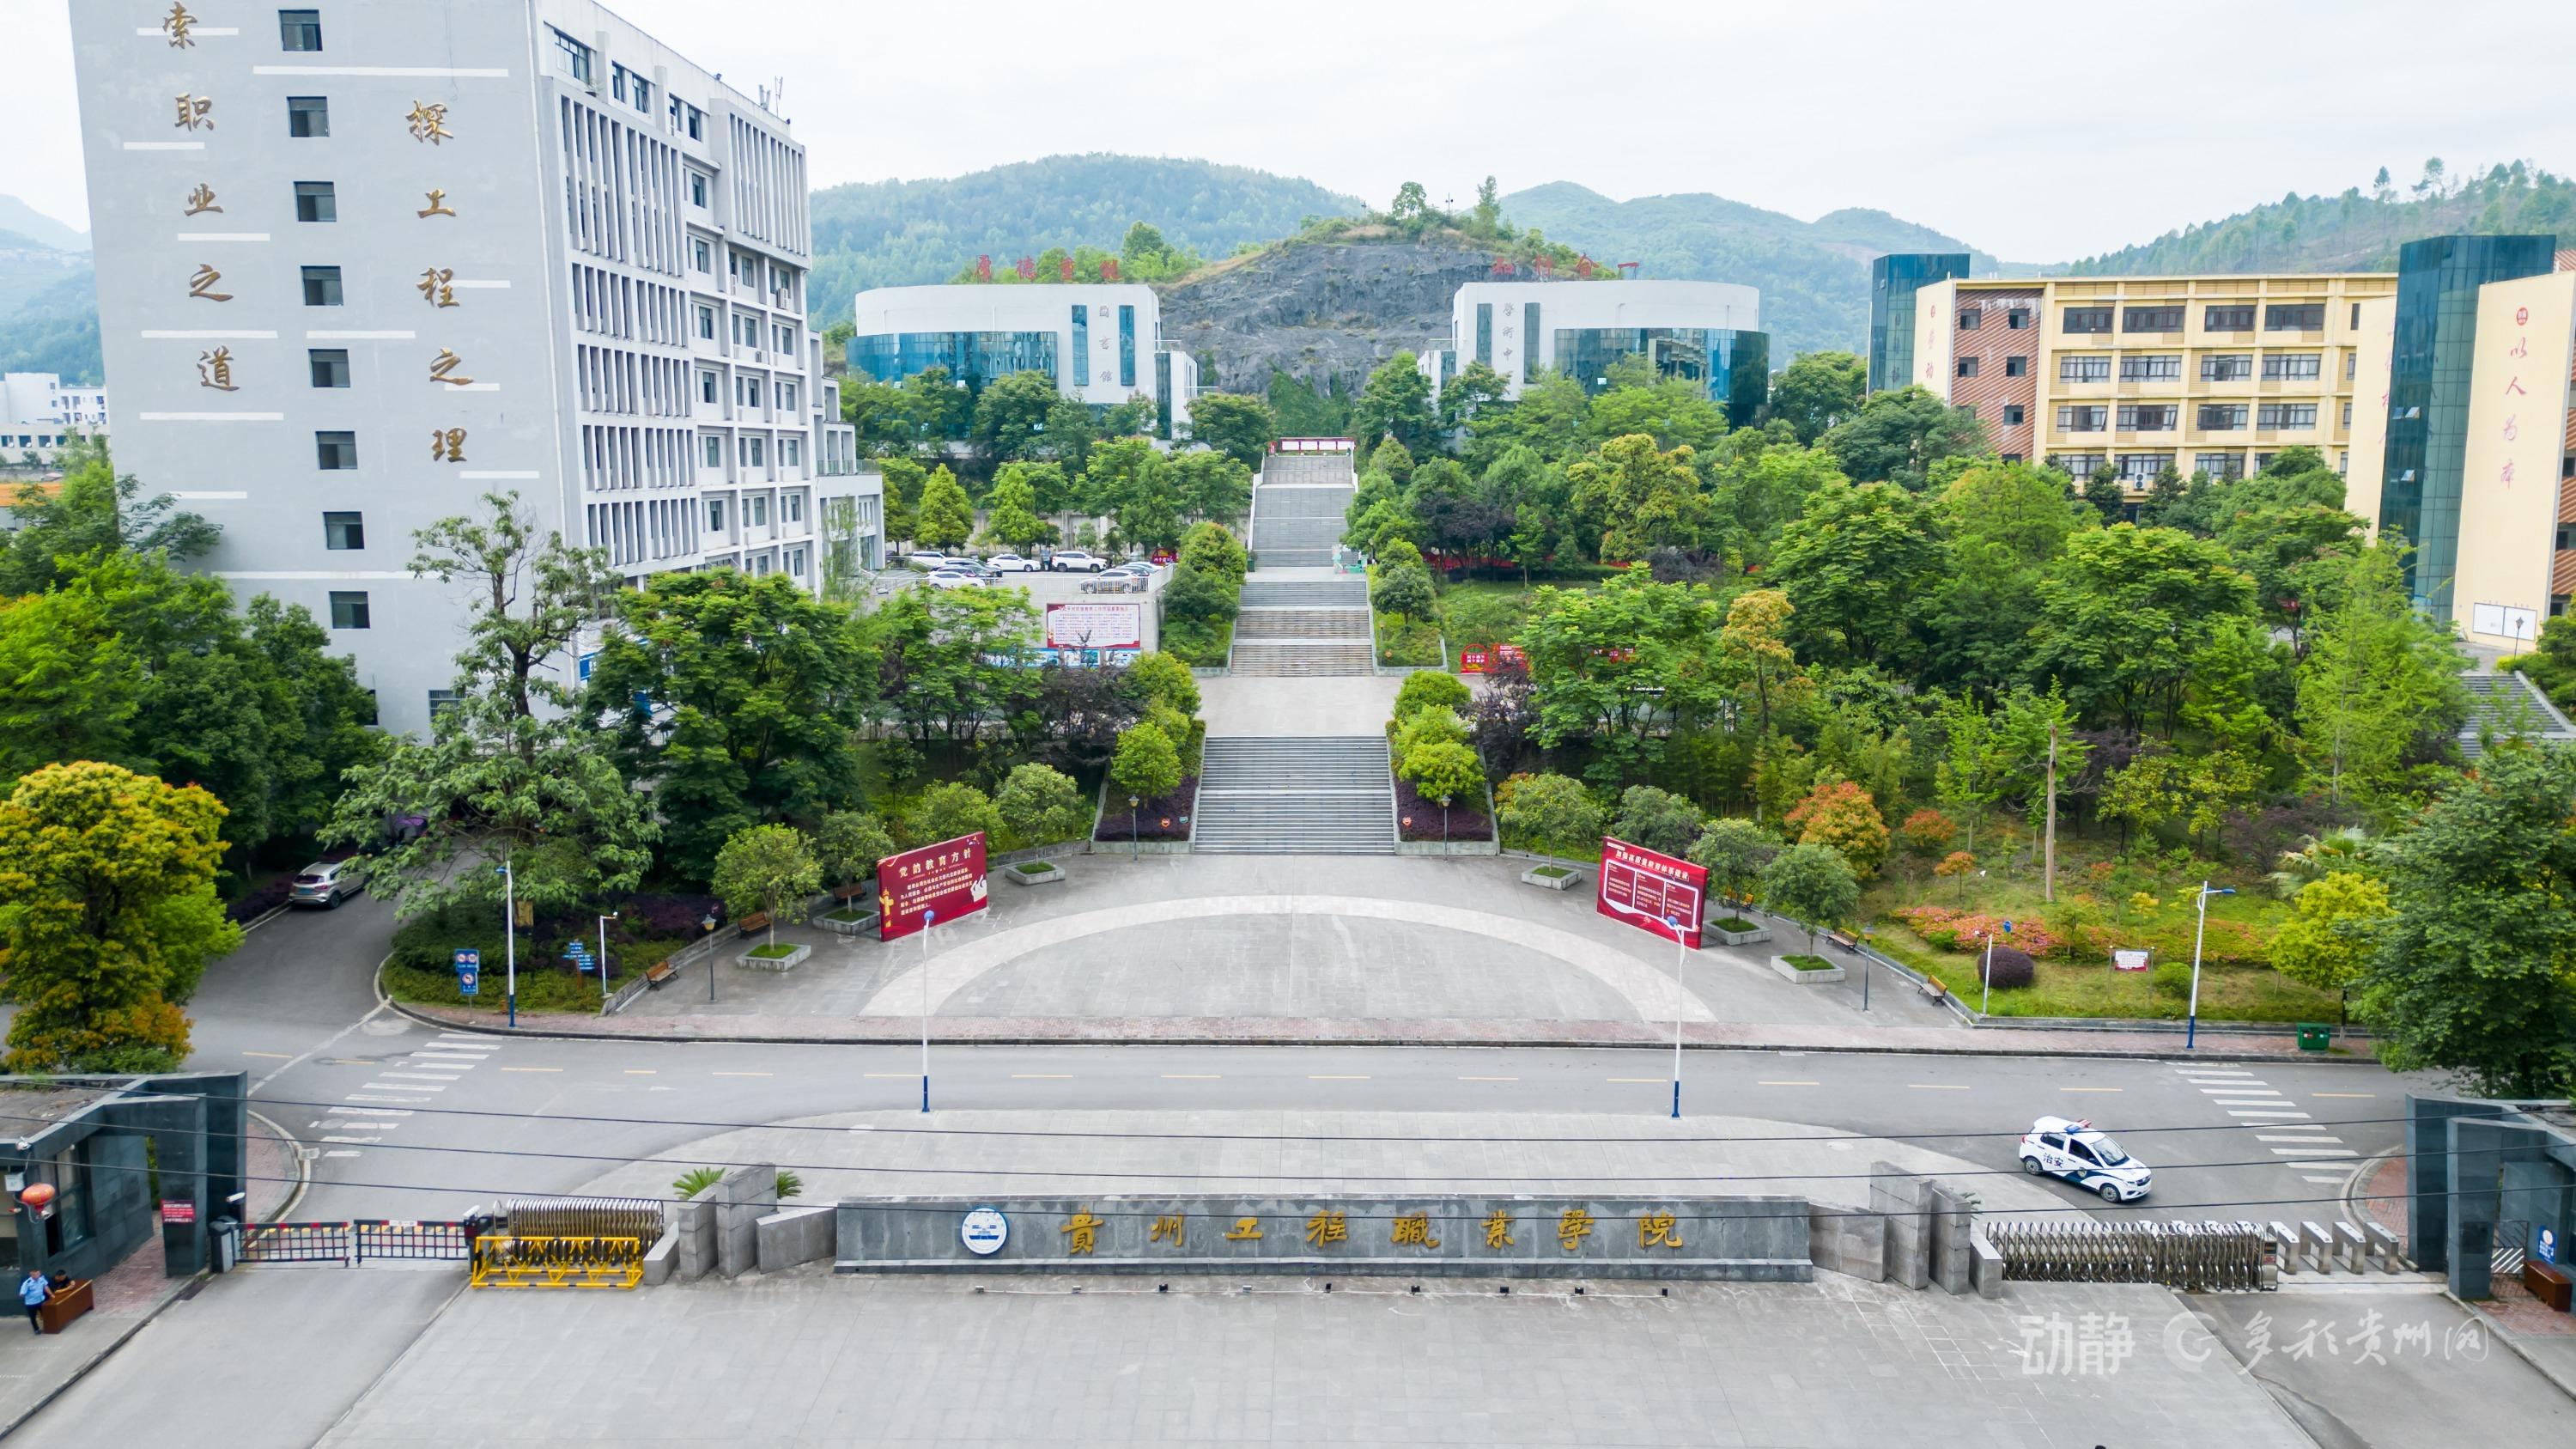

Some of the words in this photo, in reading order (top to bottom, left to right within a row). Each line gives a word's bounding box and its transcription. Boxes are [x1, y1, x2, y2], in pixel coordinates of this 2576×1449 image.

[161, 1, 241, 392] 索职业之道
[405, 99, 474, 464] 探工程之理
[898, 848, 972, 879] 党的教育方针
[2043, 1152, 2064, 1169] 治安
